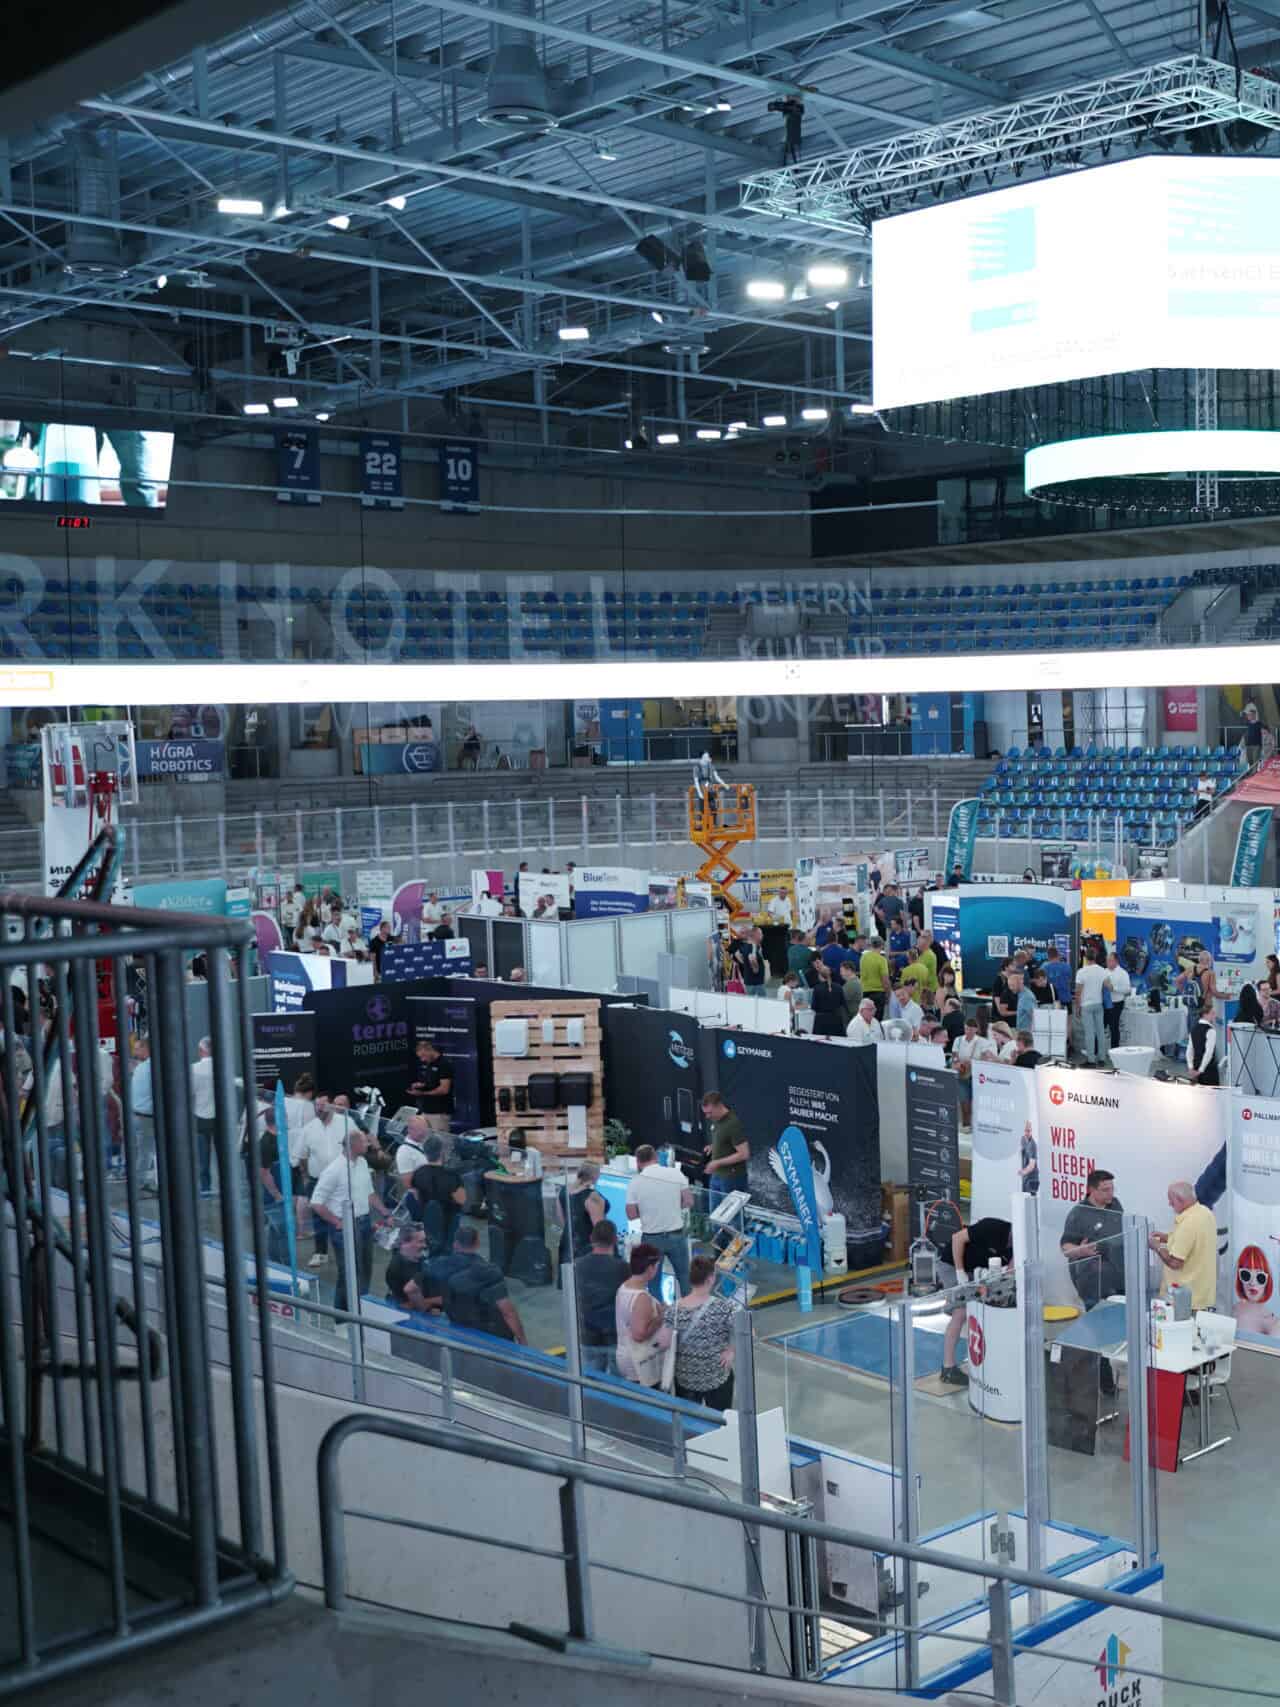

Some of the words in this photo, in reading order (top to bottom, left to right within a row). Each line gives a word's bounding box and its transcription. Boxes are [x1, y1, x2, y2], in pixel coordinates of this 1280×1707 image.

[289, 446, 306, 469] 7
[365, 452, 398, 475] 22
[446, 458, 472, 481] 10
[736, 579, 872, 615] FEIERN
[150, 743, 195, 759] HYGRA
[150, 759, 212, 772] ROBOTICS
[351, 1022, 409, 1041] terra
[352, 1039, 409, 1056] ROBOTICS
[737, 1046, 773, 1059] SZYMANEK
[811, 1101, 826, 1110] WAS
[1067, 1091, 1120, 1109] PALLMANN
[1050, 1125, 1076, 1150] WIR
[1051, 1151, 1096, 1178] LIEBEN
[781, 1141, 814, 1232] SZYMANEK
[1051, 1175, 1088, 1203] BÖDE
